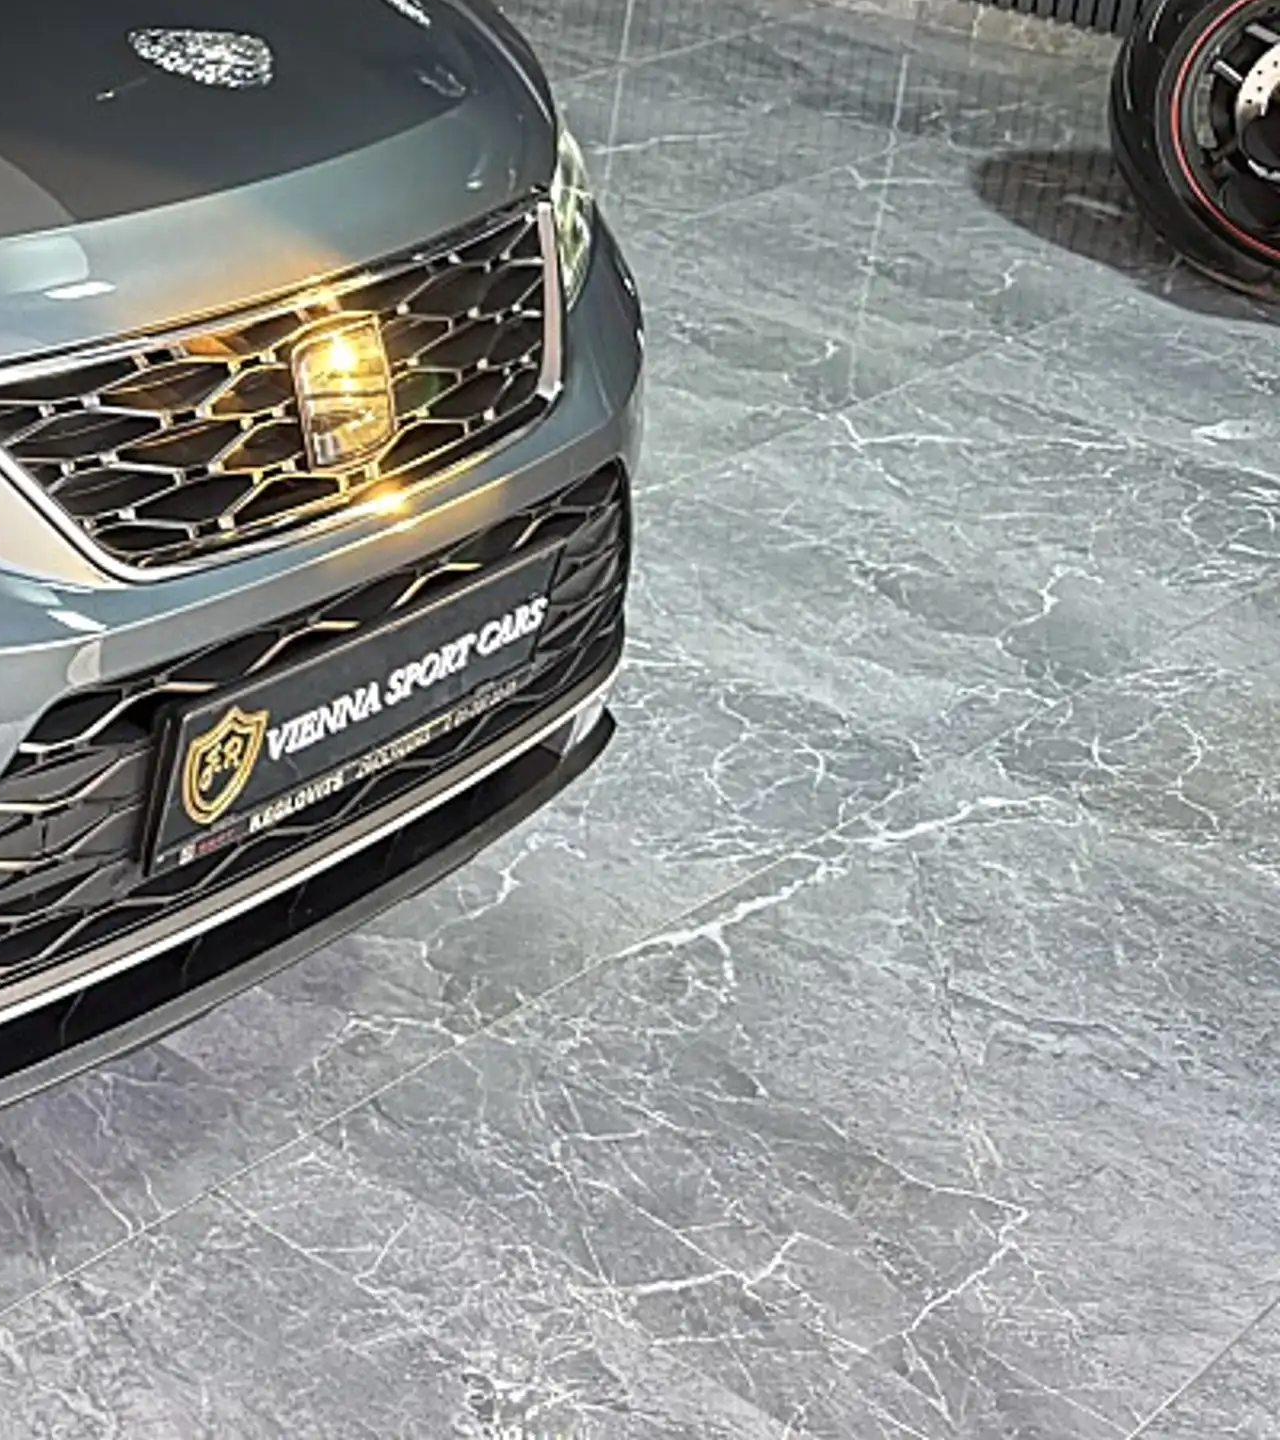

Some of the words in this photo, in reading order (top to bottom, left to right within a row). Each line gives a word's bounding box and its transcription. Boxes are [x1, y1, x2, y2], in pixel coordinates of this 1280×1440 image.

[266, 681, 383, 760] VIENNA
[384, 632, 478, 705] SPORT
[476, 596, 549, 656] CARS
